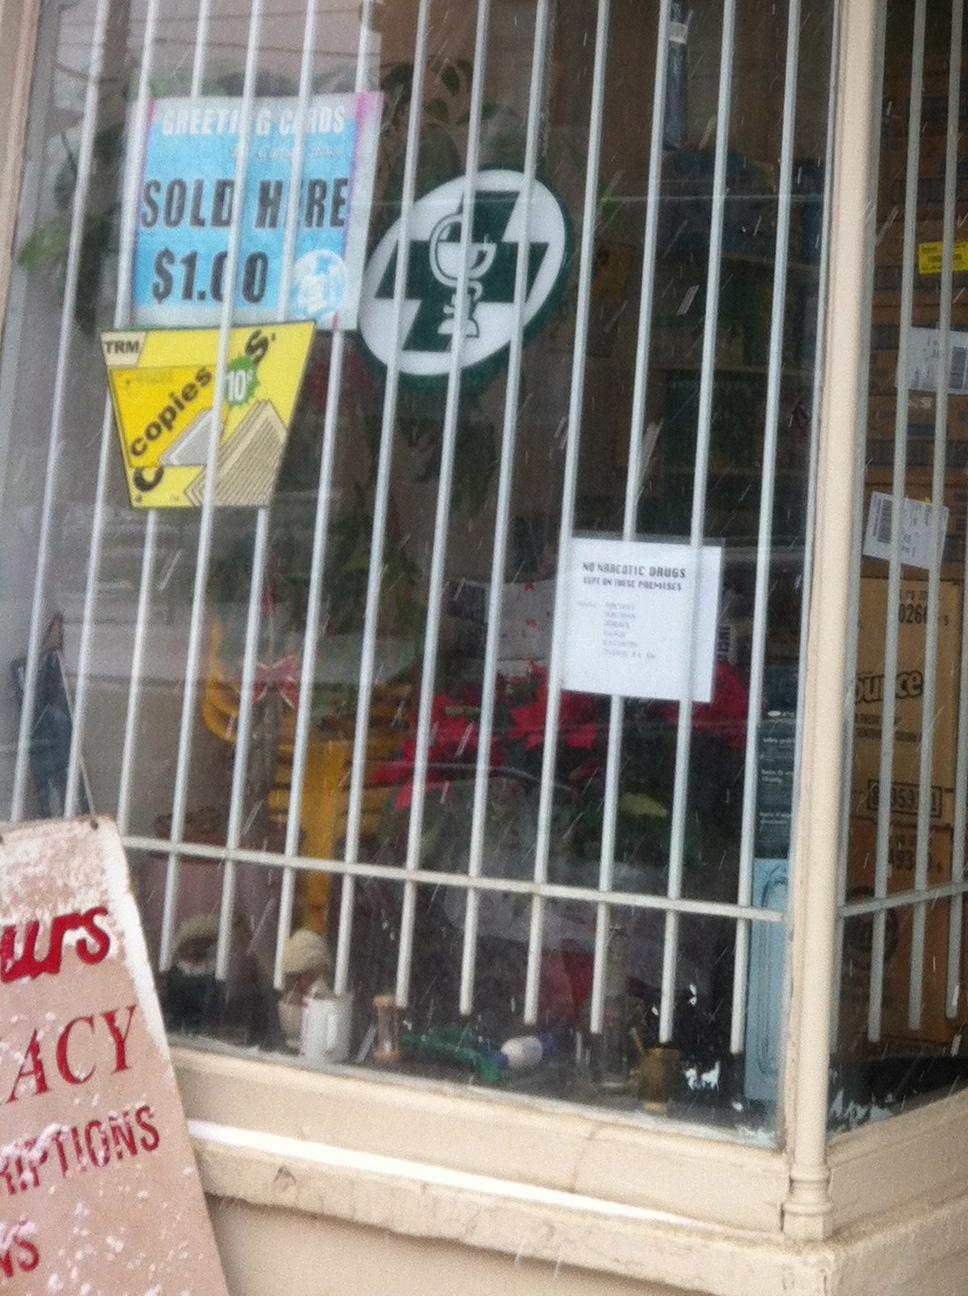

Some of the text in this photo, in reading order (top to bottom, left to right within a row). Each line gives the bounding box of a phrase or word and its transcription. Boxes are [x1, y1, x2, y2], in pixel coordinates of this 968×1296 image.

[162, 107, 271, 136] GREETIG
[141, 178, 348, 229] SOLD HRE
[104, 340, 140, 354] TRM
[130, 366, 212, 457] copies
[649, 566, 686, 578] DRUGS
